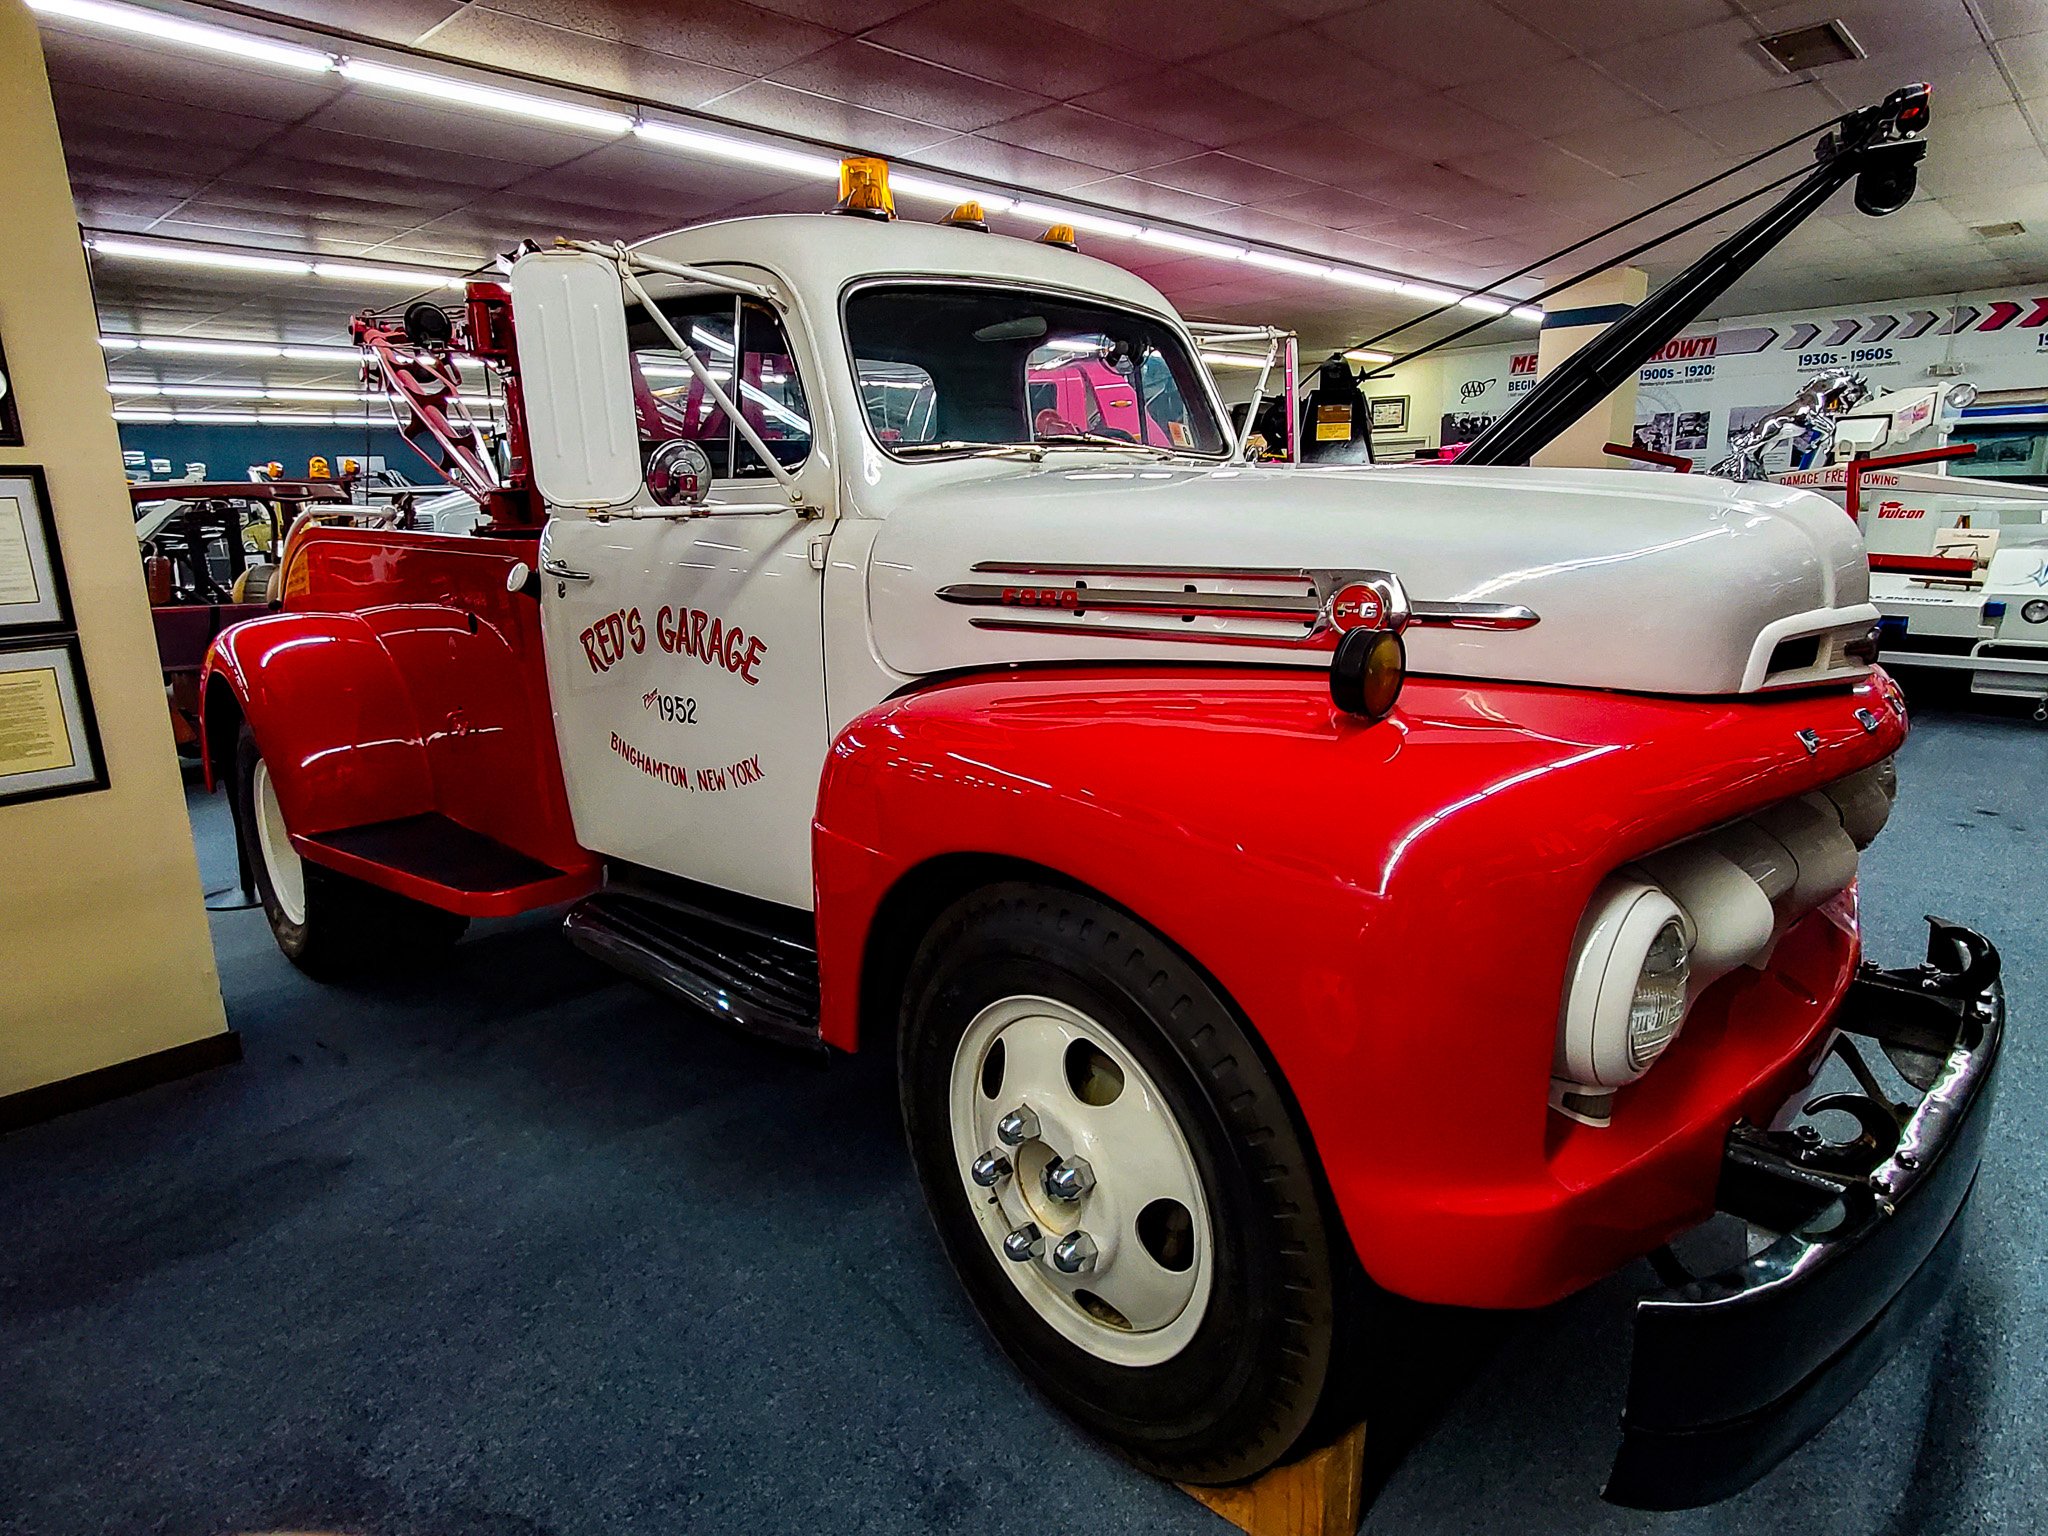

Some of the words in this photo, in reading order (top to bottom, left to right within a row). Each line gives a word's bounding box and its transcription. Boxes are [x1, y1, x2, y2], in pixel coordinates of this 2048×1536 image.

[1798, 353, 1838, 366] 1930s
[1850, 348, 1893, 362] 1960s
[1640, 369, 1674, 380] 1900s
[1780, 472, 1820, 486] DAMAGE
[1859, 473, 1899, 486] OWING
[1878, 506, 1926, 519] Vulcan
[1002, 588, 1079, 610] FORD
[1336, 601, 1379, 619] F-6
[578, 606, 647, 675] RED'S
[656, 605, 768, 686] GARAGE
[657, 694, 698, 724] 1952
[610, 730, 695, 793] BINGHAMTON,
[696, 767, 727, 792] NEW
[726, 753, 766, 789] YORK
